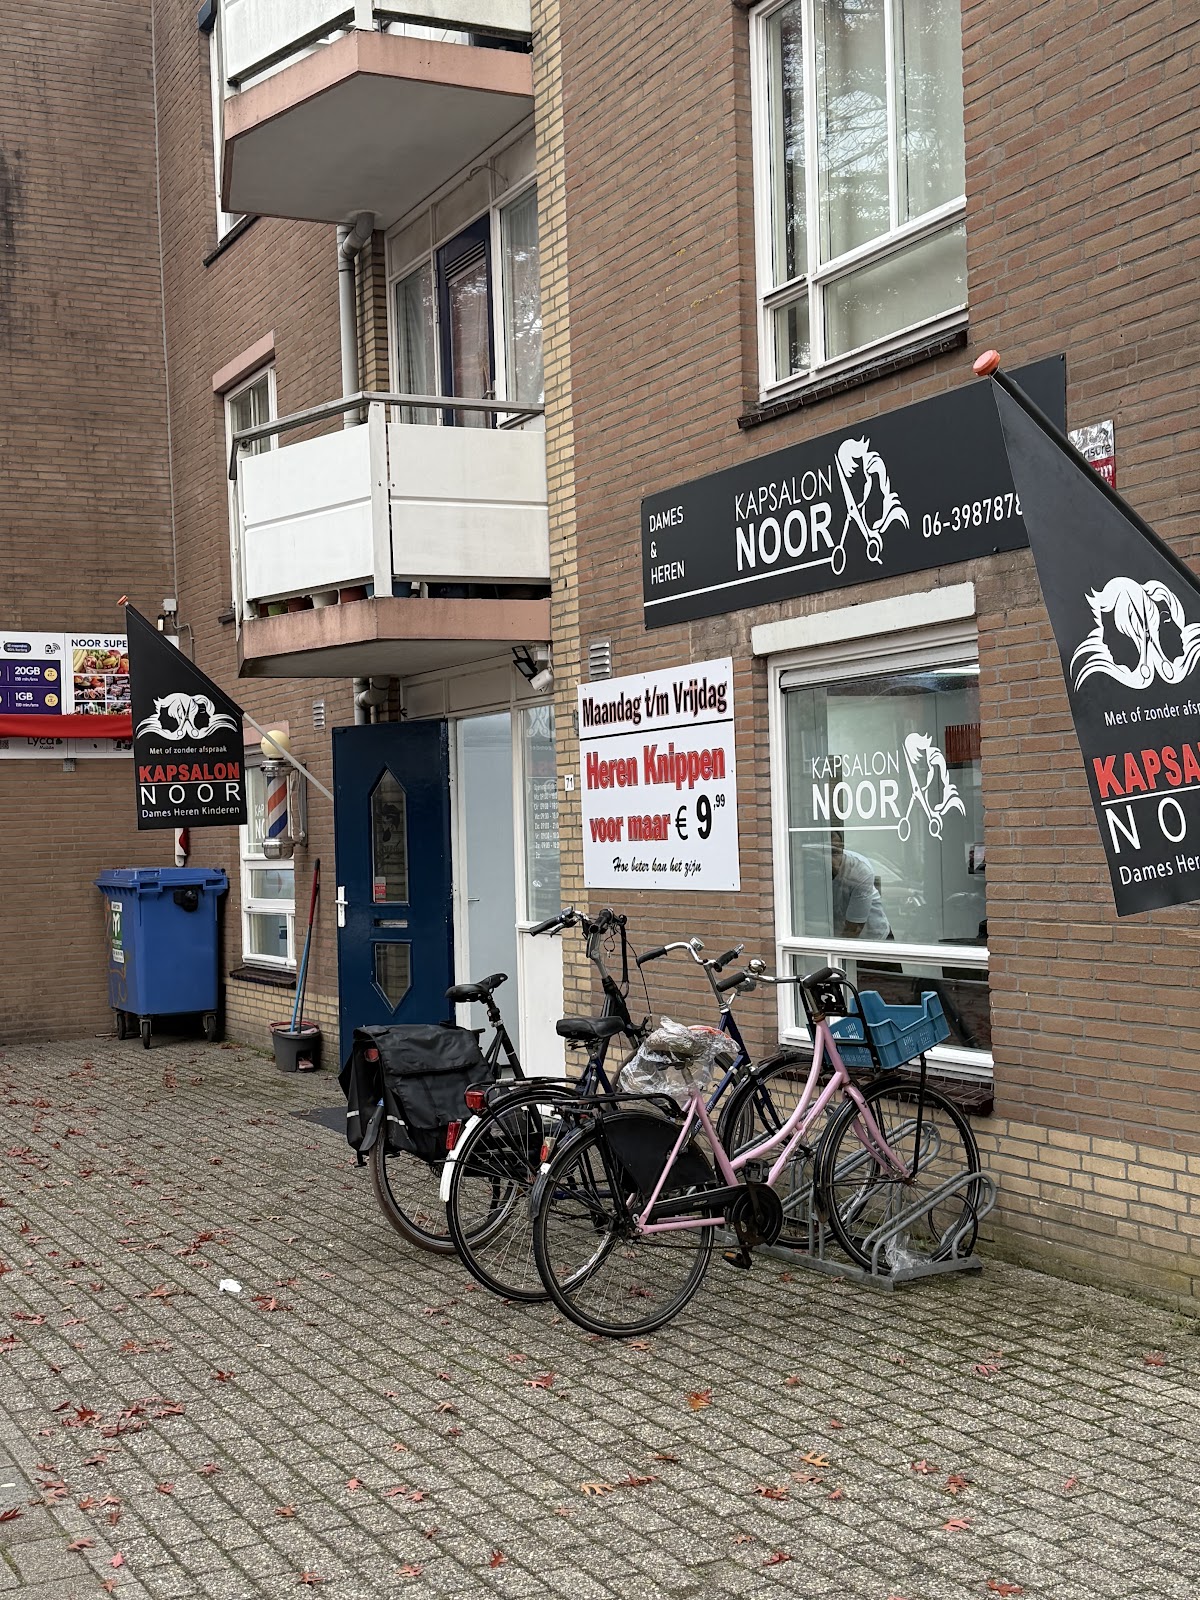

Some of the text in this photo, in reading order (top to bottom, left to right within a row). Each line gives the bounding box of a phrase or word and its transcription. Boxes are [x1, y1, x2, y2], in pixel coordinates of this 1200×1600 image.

[1084, 444, 1111, 458] risure
[734, 464, 833, 521] KAPSALON
[649, 506, 684, 533] DAMES
[736, 501, 835, 571] NOOR
[650, 541, 658, 559] &
[651, 560, 685, 585] HEREN
[71, 639, 102, 647] NOOR
[14, 666, 41, 675] 20GB
[15, 692, 33, 701] 1GB
[582, 677, 728, 728] Maandag t/m Vrijdag
[1104, 711, 1128, 726] Met
[1130, 706, 1141, 722] of
[1144, 703, 1180, 721] zonder
[149, 747, 163, 755] Met
[198, 745, 227, 754] afspraak
[139, 762, 240, 782] KAPSALON
[586, 742, 726, 791] Heren Knippen
[812, 750, 900, 779] KAPSALON
[1093, 742, 1200, 798] KAPSA
[140, 783, 241, 805] NOOR
[566, 777, 573, 789] 71
[255, 803, 265, 817] KAP
[812, 779, 901, 820] NOOR
[142, 806, 240, 818] Dames Heren Kinderen
[589, 816, 624, 842] voor
[628, 813, 671, 841] maar
[675, 805, 689, 840] €
[1105, 797, 1187, 854] NO
[612, 856, 702, 877] Hoe beter kan het zijn
[1119, 854, 1200, 885] Dames Her
